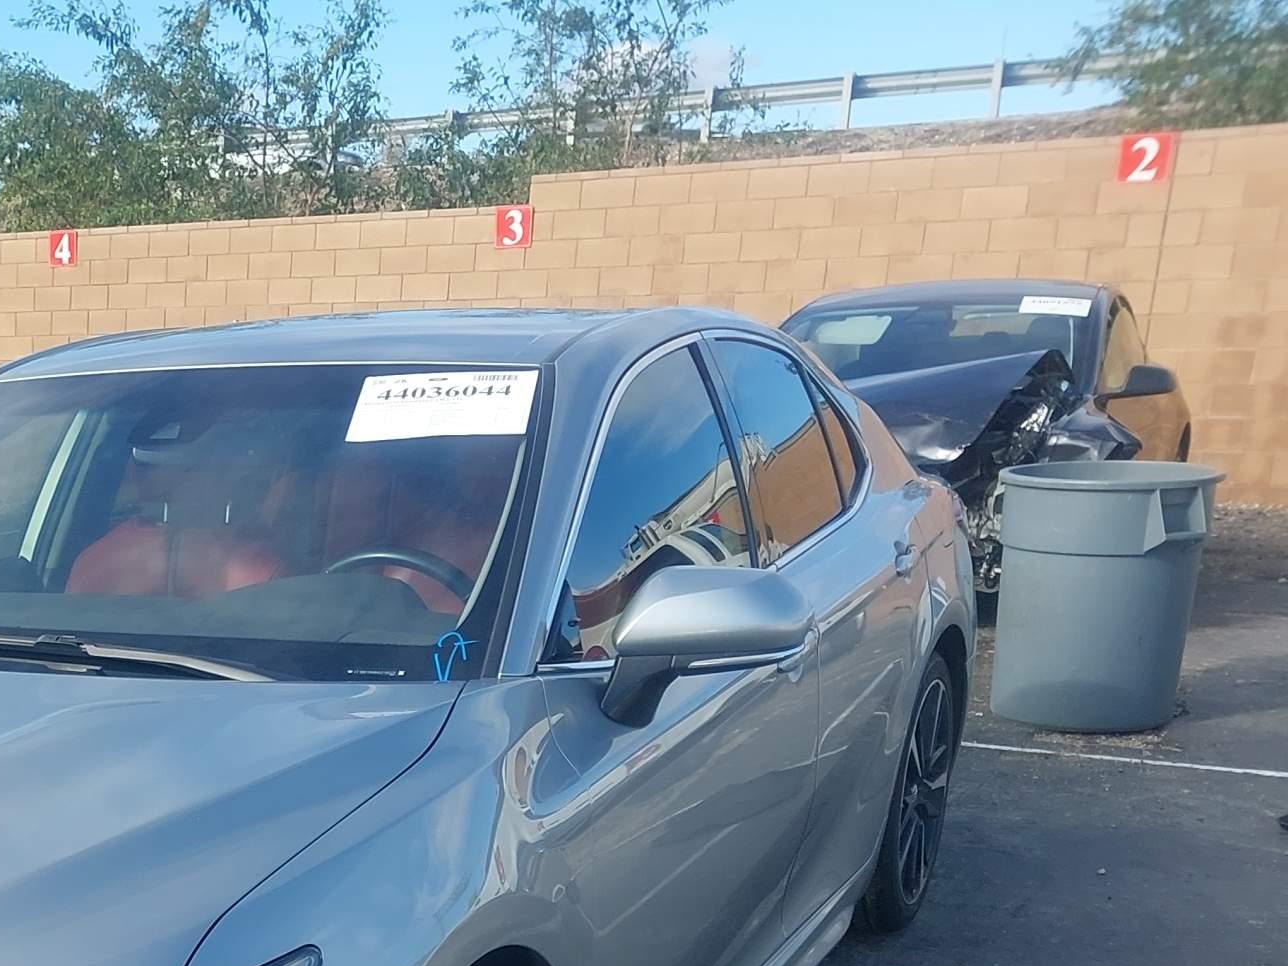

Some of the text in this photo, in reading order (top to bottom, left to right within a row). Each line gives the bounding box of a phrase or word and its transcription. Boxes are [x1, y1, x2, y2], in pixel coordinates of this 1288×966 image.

[1126, 136, 1160, 182] 2
[502, 209, 524, 246] 3
[54, 233, 71, 265] 4
[377, 384, 512, 401] 44036044
